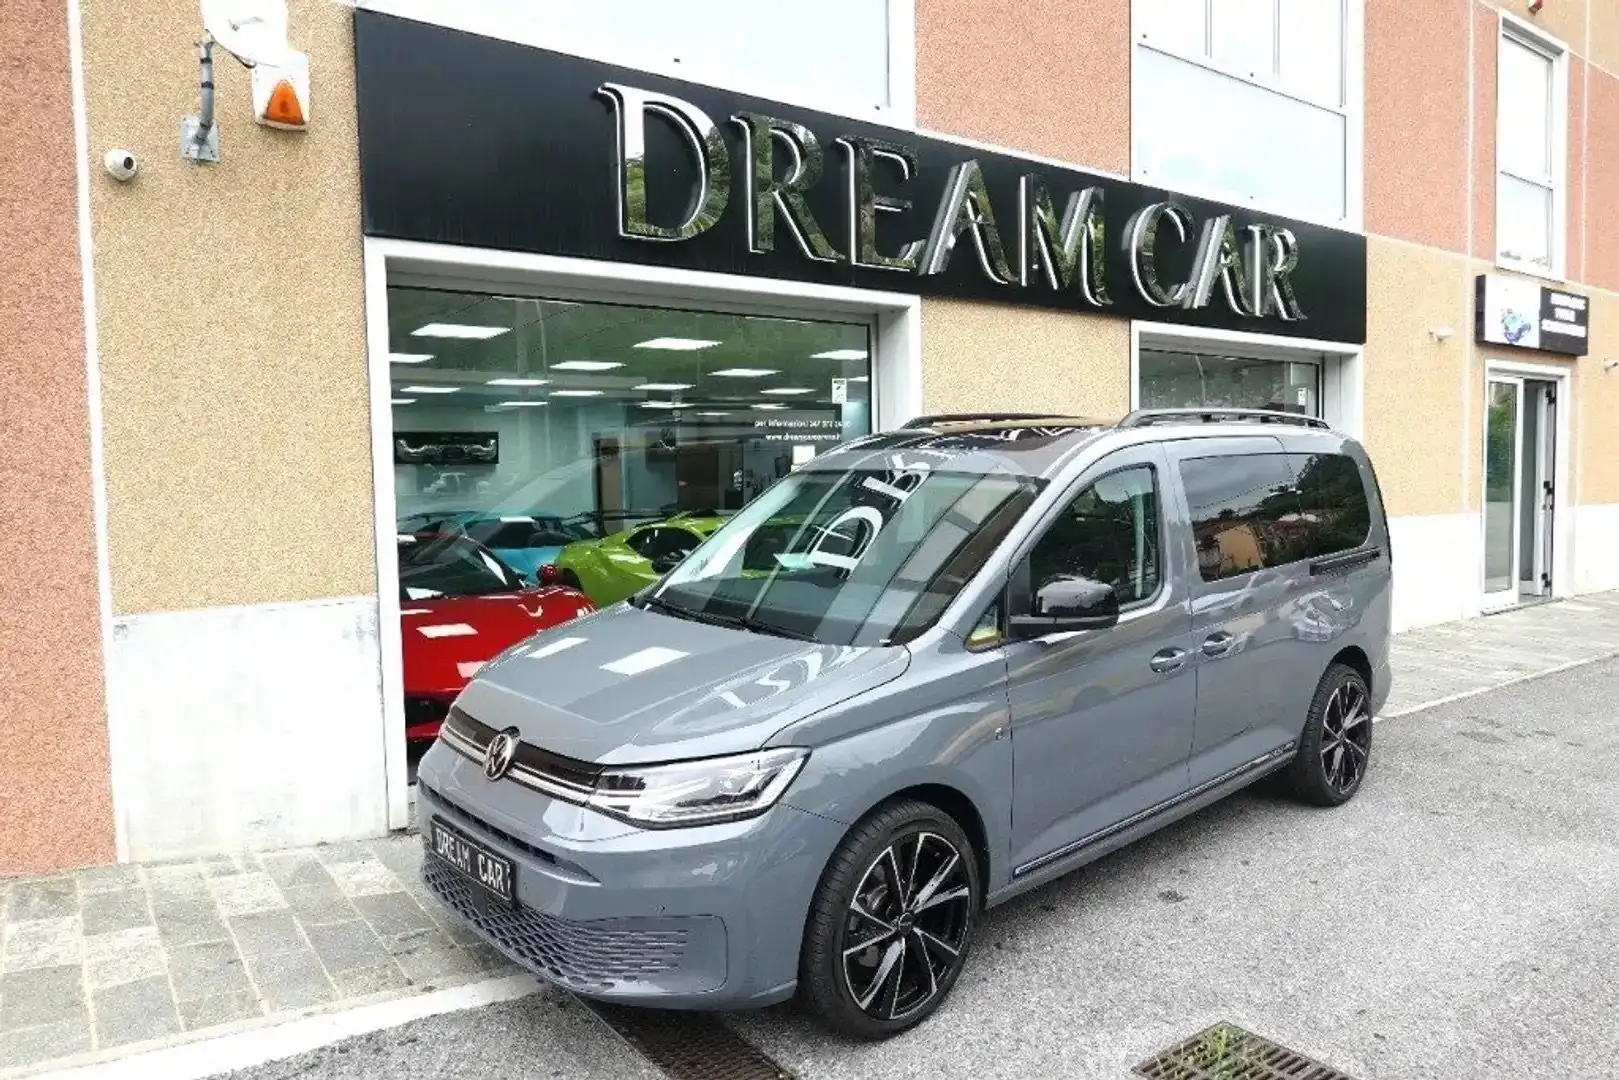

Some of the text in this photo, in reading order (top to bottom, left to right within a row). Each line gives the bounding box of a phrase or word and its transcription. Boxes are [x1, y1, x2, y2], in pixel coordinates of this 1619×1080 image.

[597, 81, 1308, 321] DREAM CAR
[435, 827, 504, 893] DREAM CAR
